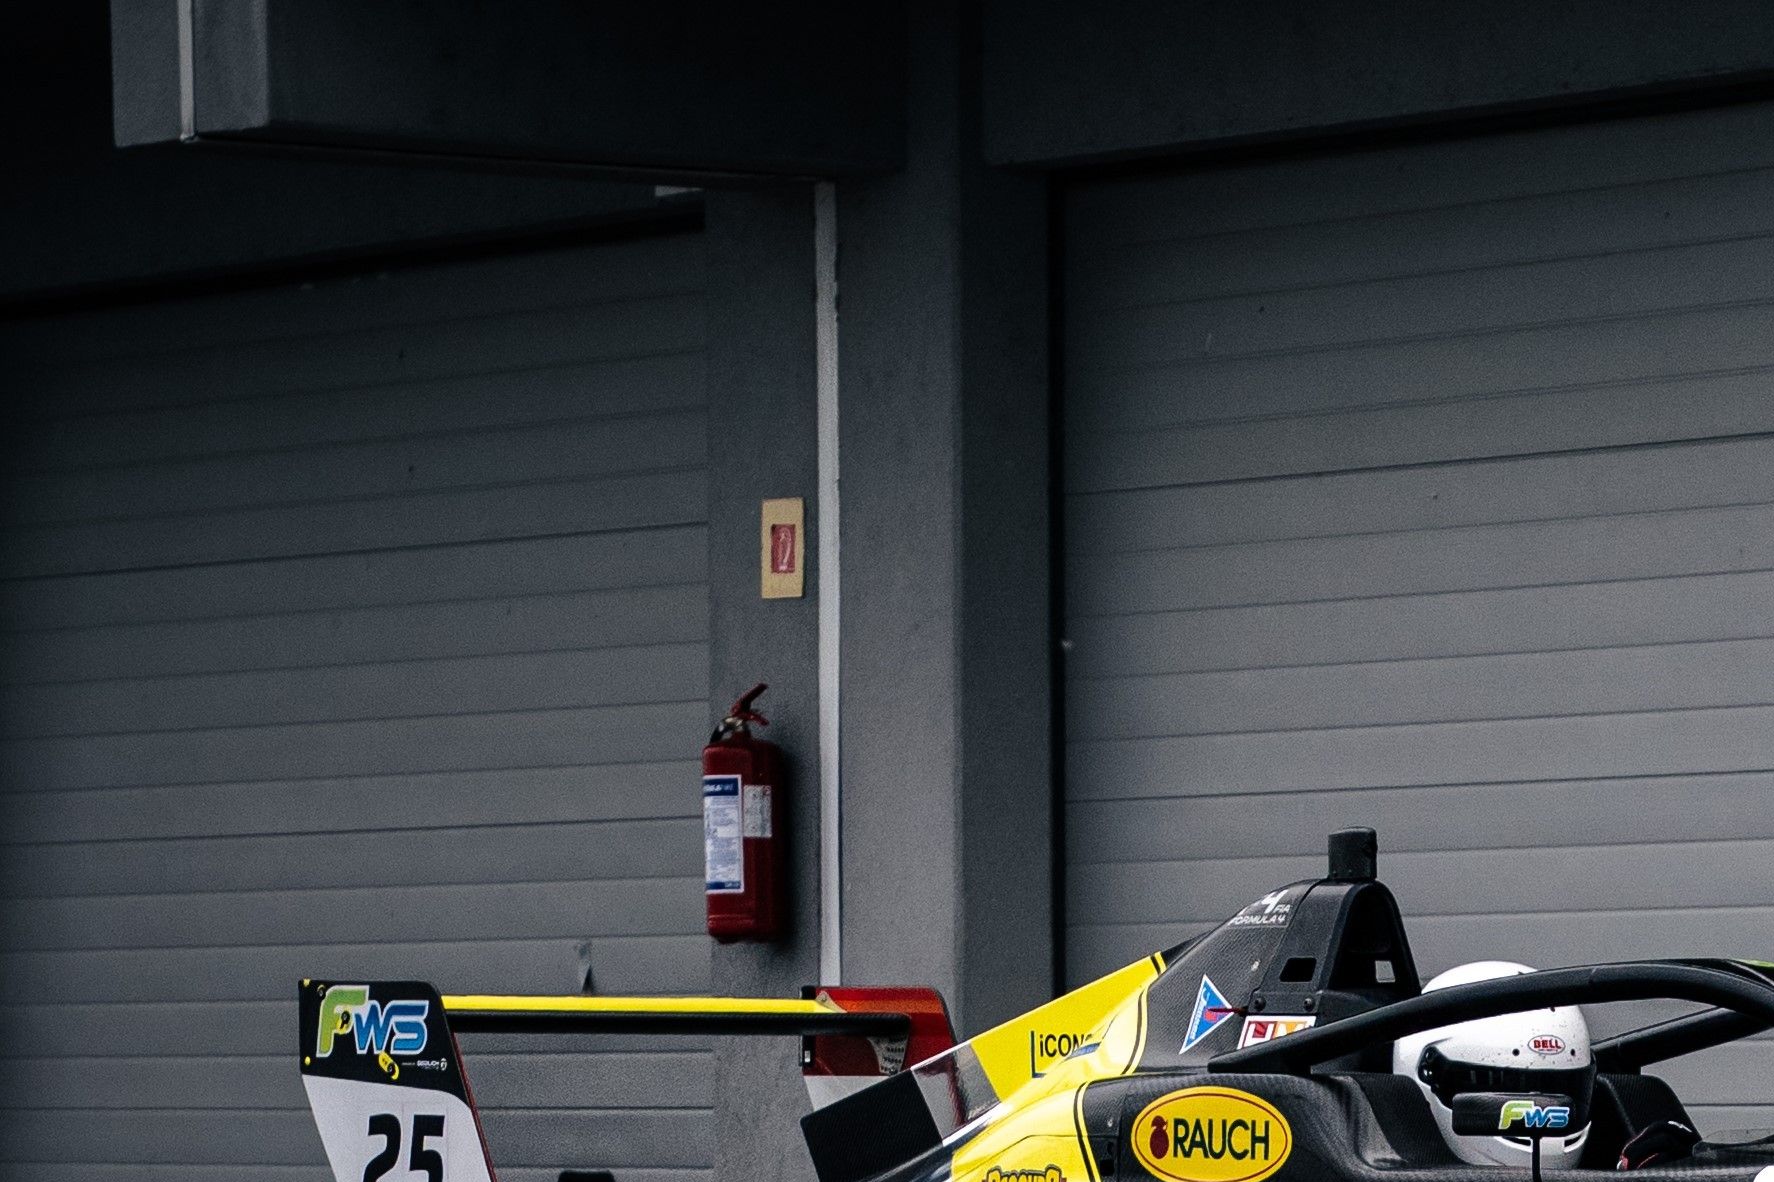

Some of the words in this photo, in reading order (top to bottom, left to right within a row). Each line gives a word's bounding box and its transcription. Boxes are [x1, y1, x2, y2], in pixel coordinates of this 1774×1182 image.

[315, 984, 429, 1058] FWS
[1533, 1039, 1562, 1049] BELL
[1497, 1100, 1570, 1130] FWS
[1173, 1118, 1270, 1160] RAUCH
